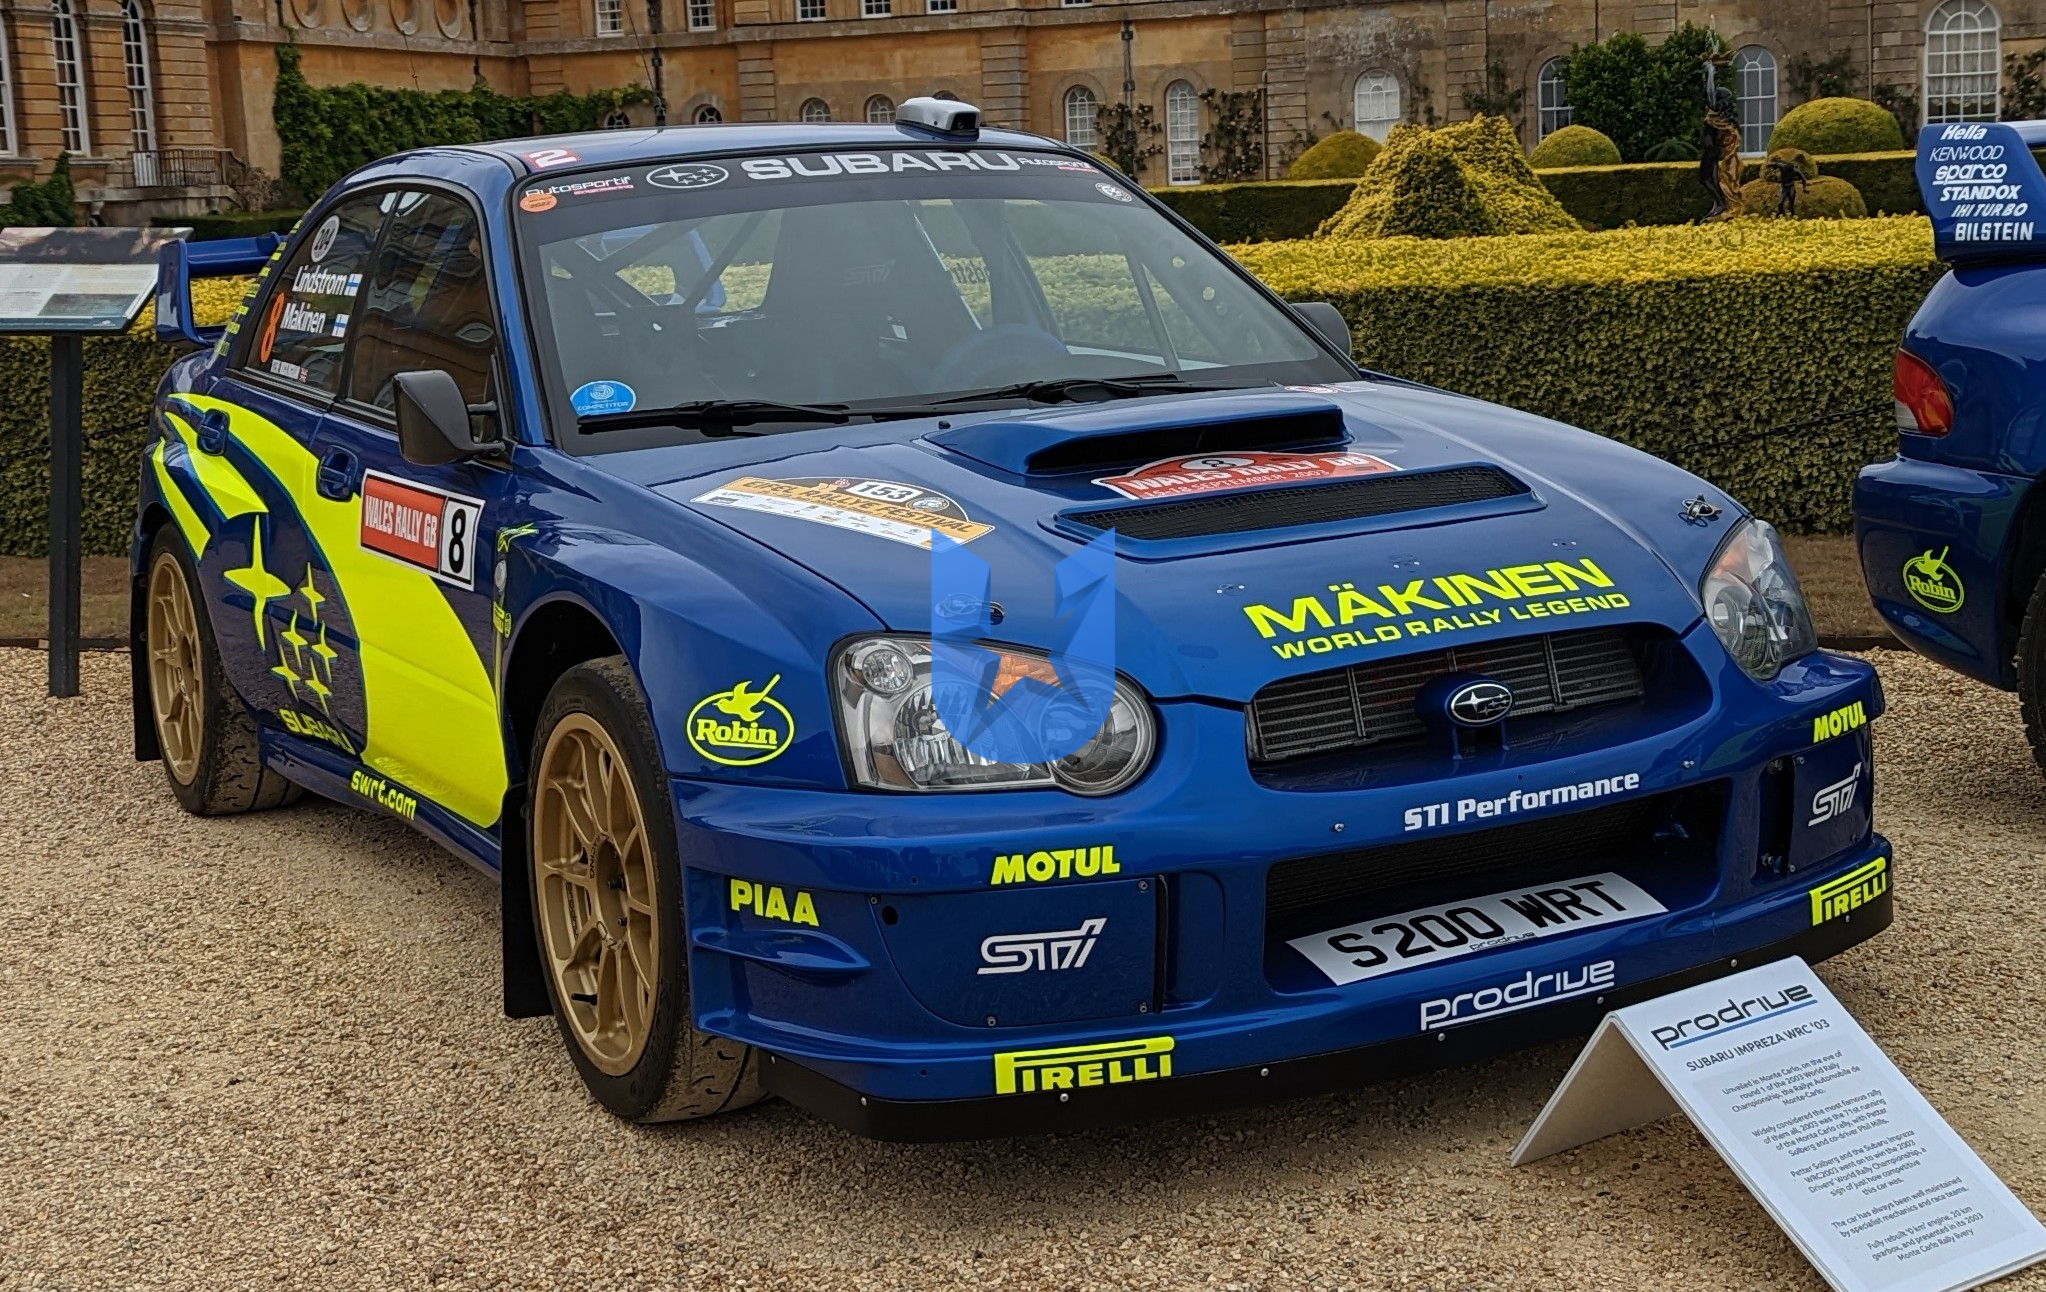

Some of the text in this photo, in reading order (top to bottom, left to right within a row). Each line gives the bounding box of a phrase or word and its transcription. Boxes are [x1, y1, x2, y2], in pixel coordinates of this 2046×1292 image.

[1941, 125, 1988, 140] Hella
[529, 149, 577, 168] 2
[740, 152, 1020, 180] SUBARU
[1929, 145, 2005, 162] KENWOOD
[1934, 163, 2008, 185] sparco
[1940, 185, 2022, 201] STANDOX
[1951, 203, 2029, 217] IHI TURBO
[1954, 222, 2034, 241] BILSTEIN
[292, 265, 348, 295] Lindstrom
[260, 292, 285, 363] 8
[280, 302, 326, 333] Makinen
[577, 401, 629, 411] COMPETITOR
[858, 484, 914, 500] 153
[1125, 470, 1232, 490] WALES
[1226, 460, 1320, 476] RALLY
[1191, 473, 1287, 490] SEPTEMBER
[365, 495, 438, 549] WALES RALLY GB
[743, 481, 798, 493] EIFEL
[799, 489, 881, 509] RALLYE
[875, 506, 974, 533] FESTIVAL
[449, 508, 467, 574] 8
[1243, 557, 1615, 639] MÄKINEN
[1908, 574, 1957, 602] Robin
[1272, 593, 1630, 660] WORLD RALLY LEGEND
[279, 708, 356, 756] SUBARU
[696, 719, 778, 748] Robin
[1813, 701, 1867, 743] MOTUL
[351, 770, 417, 821] swrt.com
[1404, 772, 1640, 832] STI Performance
[990, 845, 1120, 885] MOTUL
[730, 878, 820, 927] PIAA
[1809, 856, 1887, 927] PIRELLI
[1327, 880, 1628, 968] S200 WRT
[1469, 931, 1538, 951] prodrive
[1420, 960, 1615, 1031] prodrive
[1651, 985, 1814, 1051] prodrive
[994, 1036, 1175, 1095] PIRELLI
[1686, 1049, 1735, 1071] SUBARU
[1736, 1033, 1786, 1057] IMPREZA
[1782, 1025, 1812, 1040] WRC
[1759, 1072, 1782, 1083] Monte
[1781, 1066, 1802, 1075] Carlo,
[1834, 1050, 1842, 1058] of
[1740, 1088, 1761, 1099] round
[1766, 1083, 1774, 1091] of
[1785, 1074, 1804, 1084] 2003
[1803, 1067, 1824, 1078] World
[1823, 1063, 1840, 1071] Rally
[1781, 1088, 1794, 1096] the
[1793, 1082, 1814, 1091] Rallye
[1752, 1126, 1776, 1137] Widely
[1776, 1112, 1813, 1129] considered
[1824, 1103, 1843, 1112] most
[1841, 1095, 1867, 1106] famous
[1867, 1089, 1882, 1097] rally
[1763, 1136, 1772, 1144] of
[1771, 1132, 1790, 1141] them
[1800, 1121, 1819, 1131] 2003
[1818, 1117, 1833, 1125] was
[1843, 1107, 1861, 1116] 71st
[1860, 1098, 1887, 1110] running
[1776, 1108, 1887, 1151] of the Monte Carlo rally, with Petter
[1788, 1123, 1872, 1157] Solberg and co-driver Phil
[1790, 1166, 1812, 1177] Petter
[1812, 1157, 1840, 1169] Solberg
[1839, 1151, 1853, 1160] and
[1863, 1140, 1888, 1151] Subaru
[1887, 1130, 1915, 1143] Impreza
[1804, 1167, 1839, 1183] WRC2003
[1838, 1161, 1857, 1171] went
[1897, 1139, 1916, 1150] 2003
[1830, 1160, 1920, 1196] sign of just how competitive
[1834, 1171, 1857, 1183] World
[1855, 1166, 1873, 1176] Rally
[1831, 1176, 1962, 1229] The car has always been well maintained
[1862, 1187, 1877, 1195] this
[1876, 1182, 1887, 1190] car
[1850, 1217, 1883, 1234] specialist
[1882, 1205, 1918, 1221] mechanics
[1918, 1198, 1932, 1208] and
[1931, 1194, 1946, 1203] race
[1945, 1187, 1969, 1197] teams.
[1867, 1240, 1885, 1250] Fully
[1950, 1210, 1961, 1218] 20
[1959, 1206, 1973, 1214] km
[1897, 1229, 1974, 1261] Monte Carlo Rally livery
[1902, 1238, 1916, 1248] and
[1915, 1226, 1949, 1244] presented
[1964, 1212, 1984, 1224] 2003
